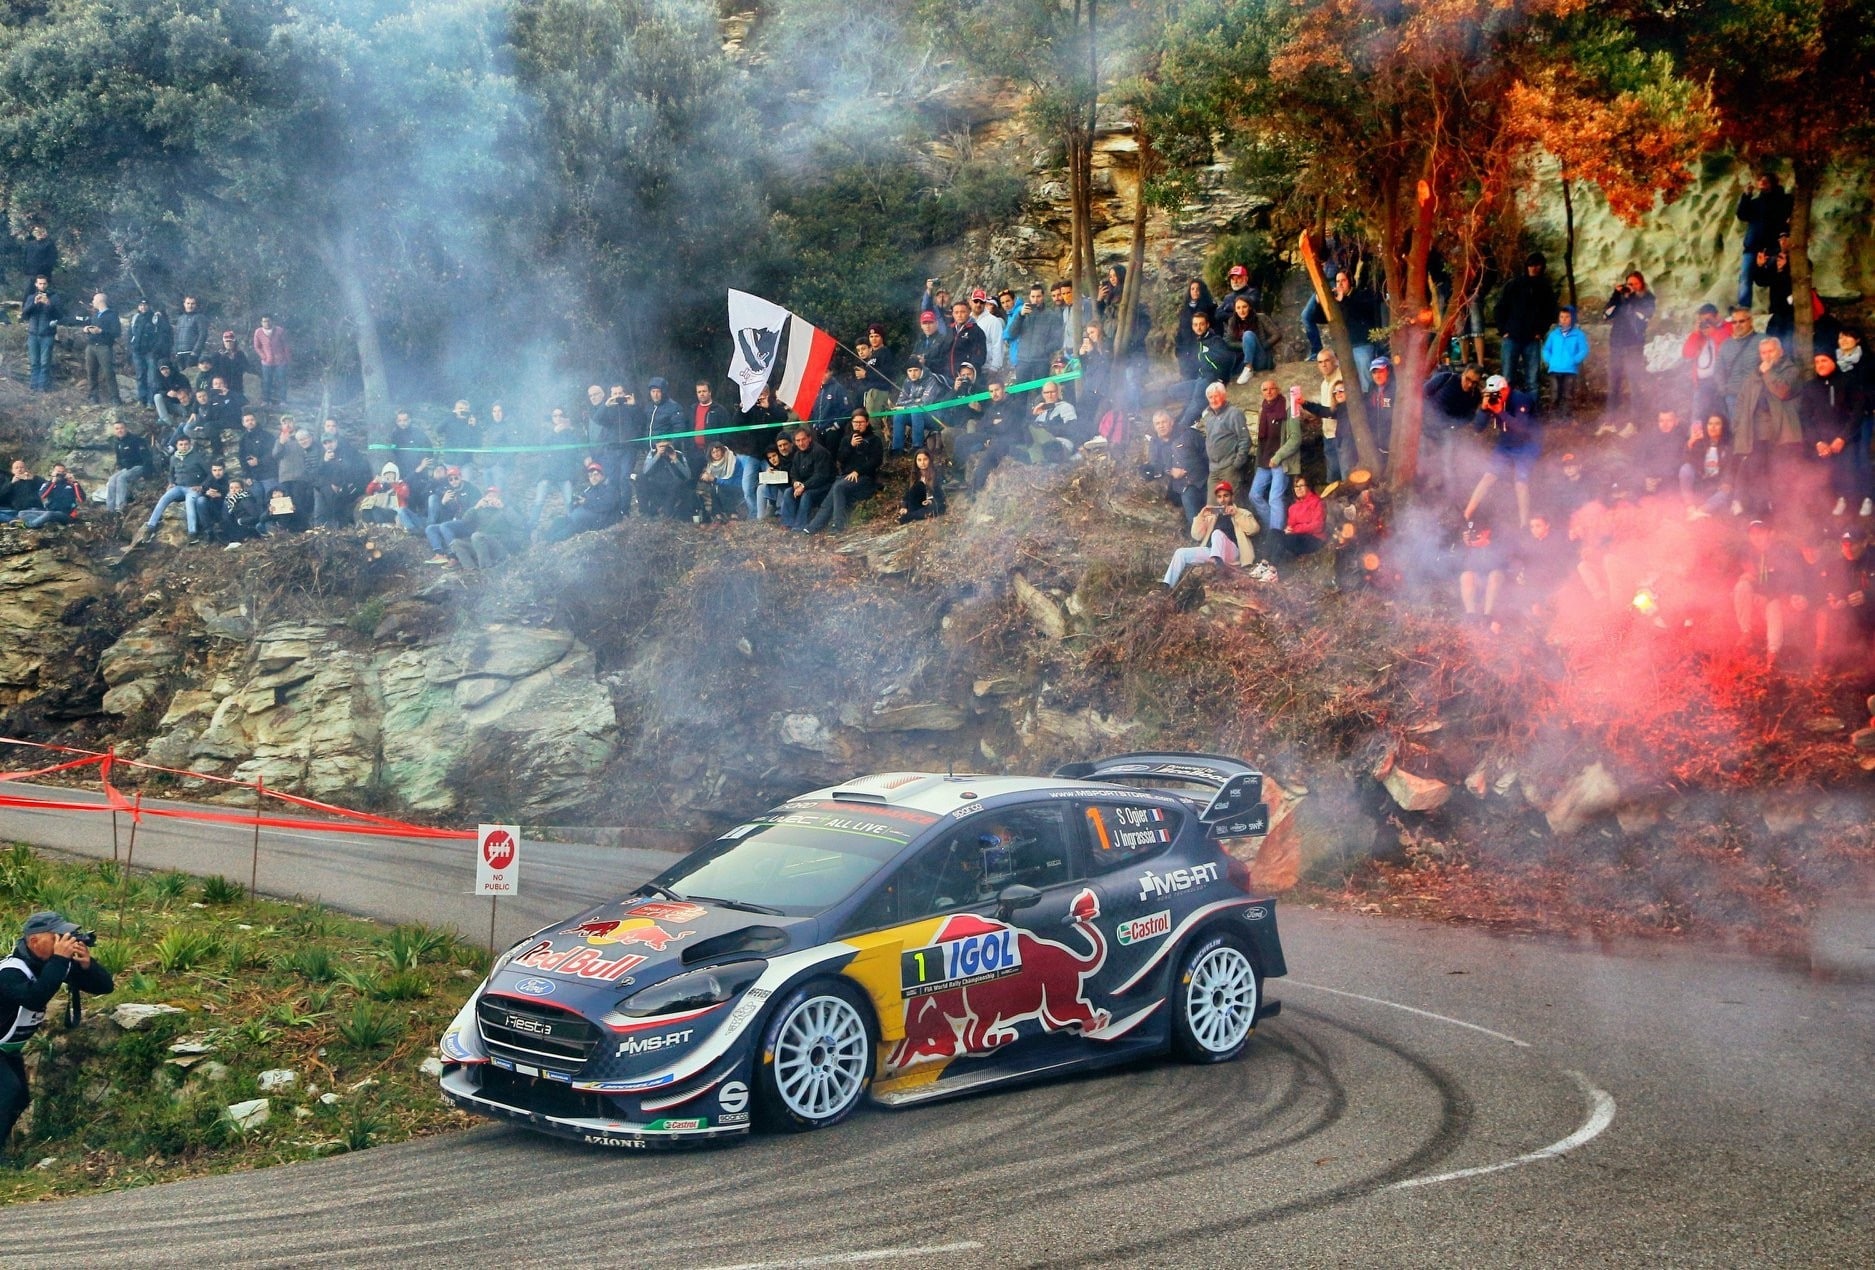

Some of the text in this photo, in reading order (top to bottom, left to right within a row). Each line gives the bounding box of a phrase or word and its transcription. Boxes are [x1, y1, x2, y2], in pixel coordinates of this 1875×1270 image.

[951, 803, 983, 818] sparco
[1115, 807, 1149, 827] S Ogier
[825, 818, 850, 829] ALL
[852, 821, 888, 834] LIVE
[1085, 806, 1111, 849] 1
[1114, 827, 1157, 850] J Ingrassia
[1153, 862, 1217, 896] MS-RT
[1244, 907, 1266, 920] Ford
[1131, 914, 1169, 940] Castrol
[513, 940, 580, 972] Red
[555, 947, 649, 982] Bull
[949, 930, 1014, 979] IGOL
[914, 952, 926, 982] 1
[518, 978, 550, 995] Ford
[933, 983, 948, 992] World
[949, 979, 962, 988] Rally
[962, 973, 995, 985] Championship
[505, 1015, 552, 1035] Fiesta
[628, 1029, 694, 1055] MS-RT
[671, 1120, 698, 1130] Castrol
